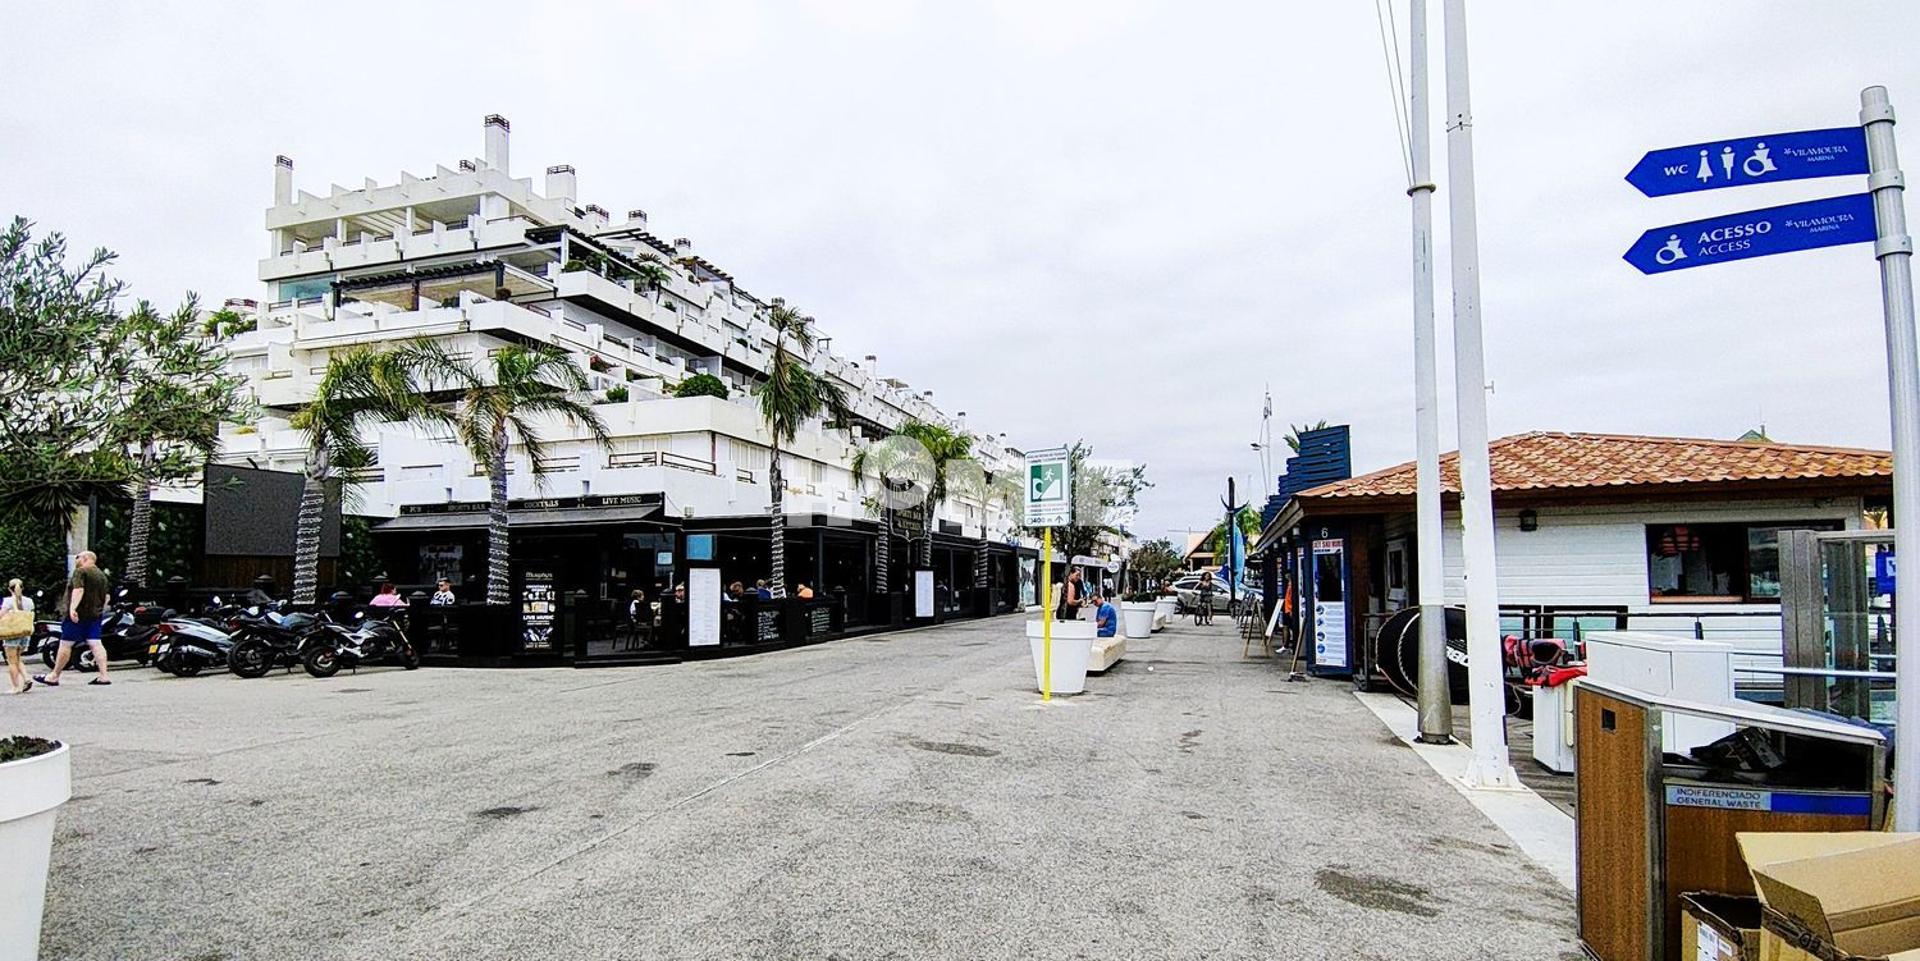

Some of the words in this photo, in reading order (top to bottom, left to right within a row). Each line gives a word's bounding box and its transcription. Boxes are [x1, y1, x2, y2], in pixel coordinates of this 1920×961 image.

[1792, 144, 1849, 158] VILAMOURA
[1807, 154, 1836, 163] MARINA
[1663, 164, 1689, 176] WC
[1795, 213, 1854, 230] VILAMOURA
[1698, 220, 1772, 244] ACESSO
[1809, 222, 1840, 234] MARINA
[1698, 240, 1751, 257] ACCESS
[524, 500, 559, 509] COCKTAILS
[602, 497, 618, 505] LIVE
[620, 496, 642, 504] MUSIC
[1321, 527, 1329, 539] 6
[1676, 788, 1761, 800] INDIFERENCIADO
[1676, 796, 1724, 807] GENERAL
[1726, 799, 1761, 808] WASTE
